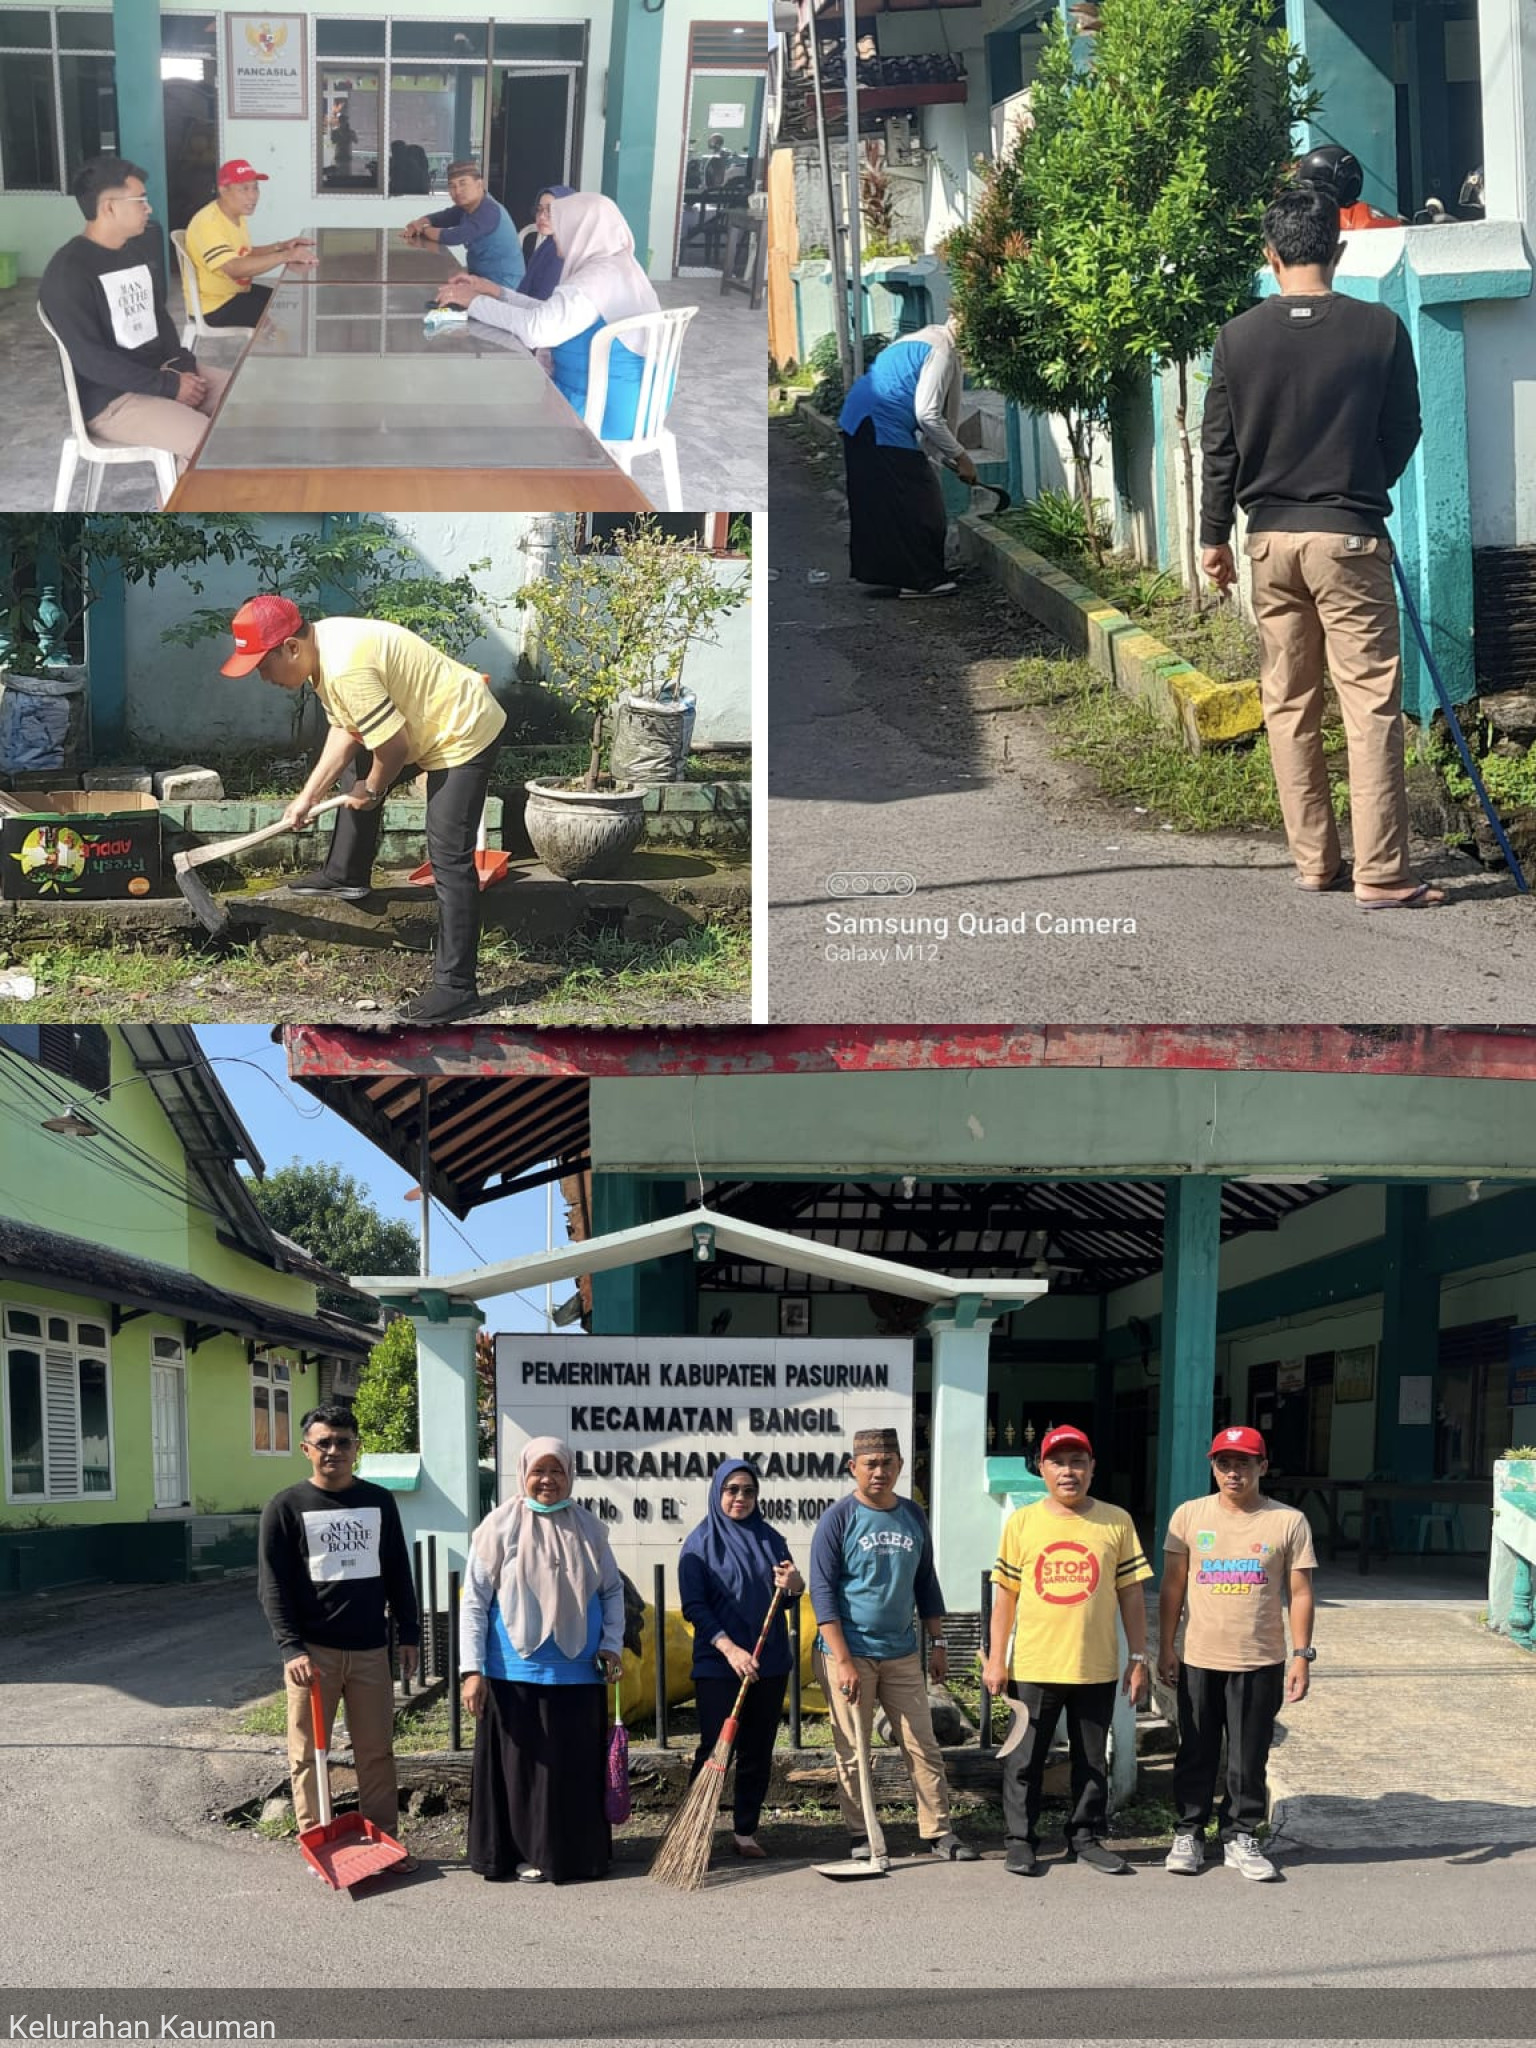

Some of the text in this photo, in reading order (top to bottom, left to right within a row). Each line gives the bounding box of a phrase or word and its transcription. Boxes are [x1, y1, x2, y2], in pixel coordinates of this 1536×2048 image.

[237, 67, 297, 76] PANCASILA
[91, 856, 146, 873] Fresh
[522, 1361, 888, 1388] PEMERINTAH KABUPATEN PASURUAN
[571, 1406, 841, 1433] KECAMATAN BANGIL
[576, 1450, 854, 1478] LURAHAN KAUMA
[600, 1497, 617, 1520] No
[633, 1497, 649, 1520] 09
[760, 1498, 792, 1521] 3085
[330, 1520, 363, 1532] MAN
[320, 1528, 373, 1543] ON THE
[859, 1531, 914, 1552] EIGER
[1043, 1560, 1090, 1576] STOP
[1202, 1558, 1263, 1572] BANGIL
[1196, 1570, 1269, 1584] CARNIVAL
[1211, 1583, 1252, 1595] 2025
